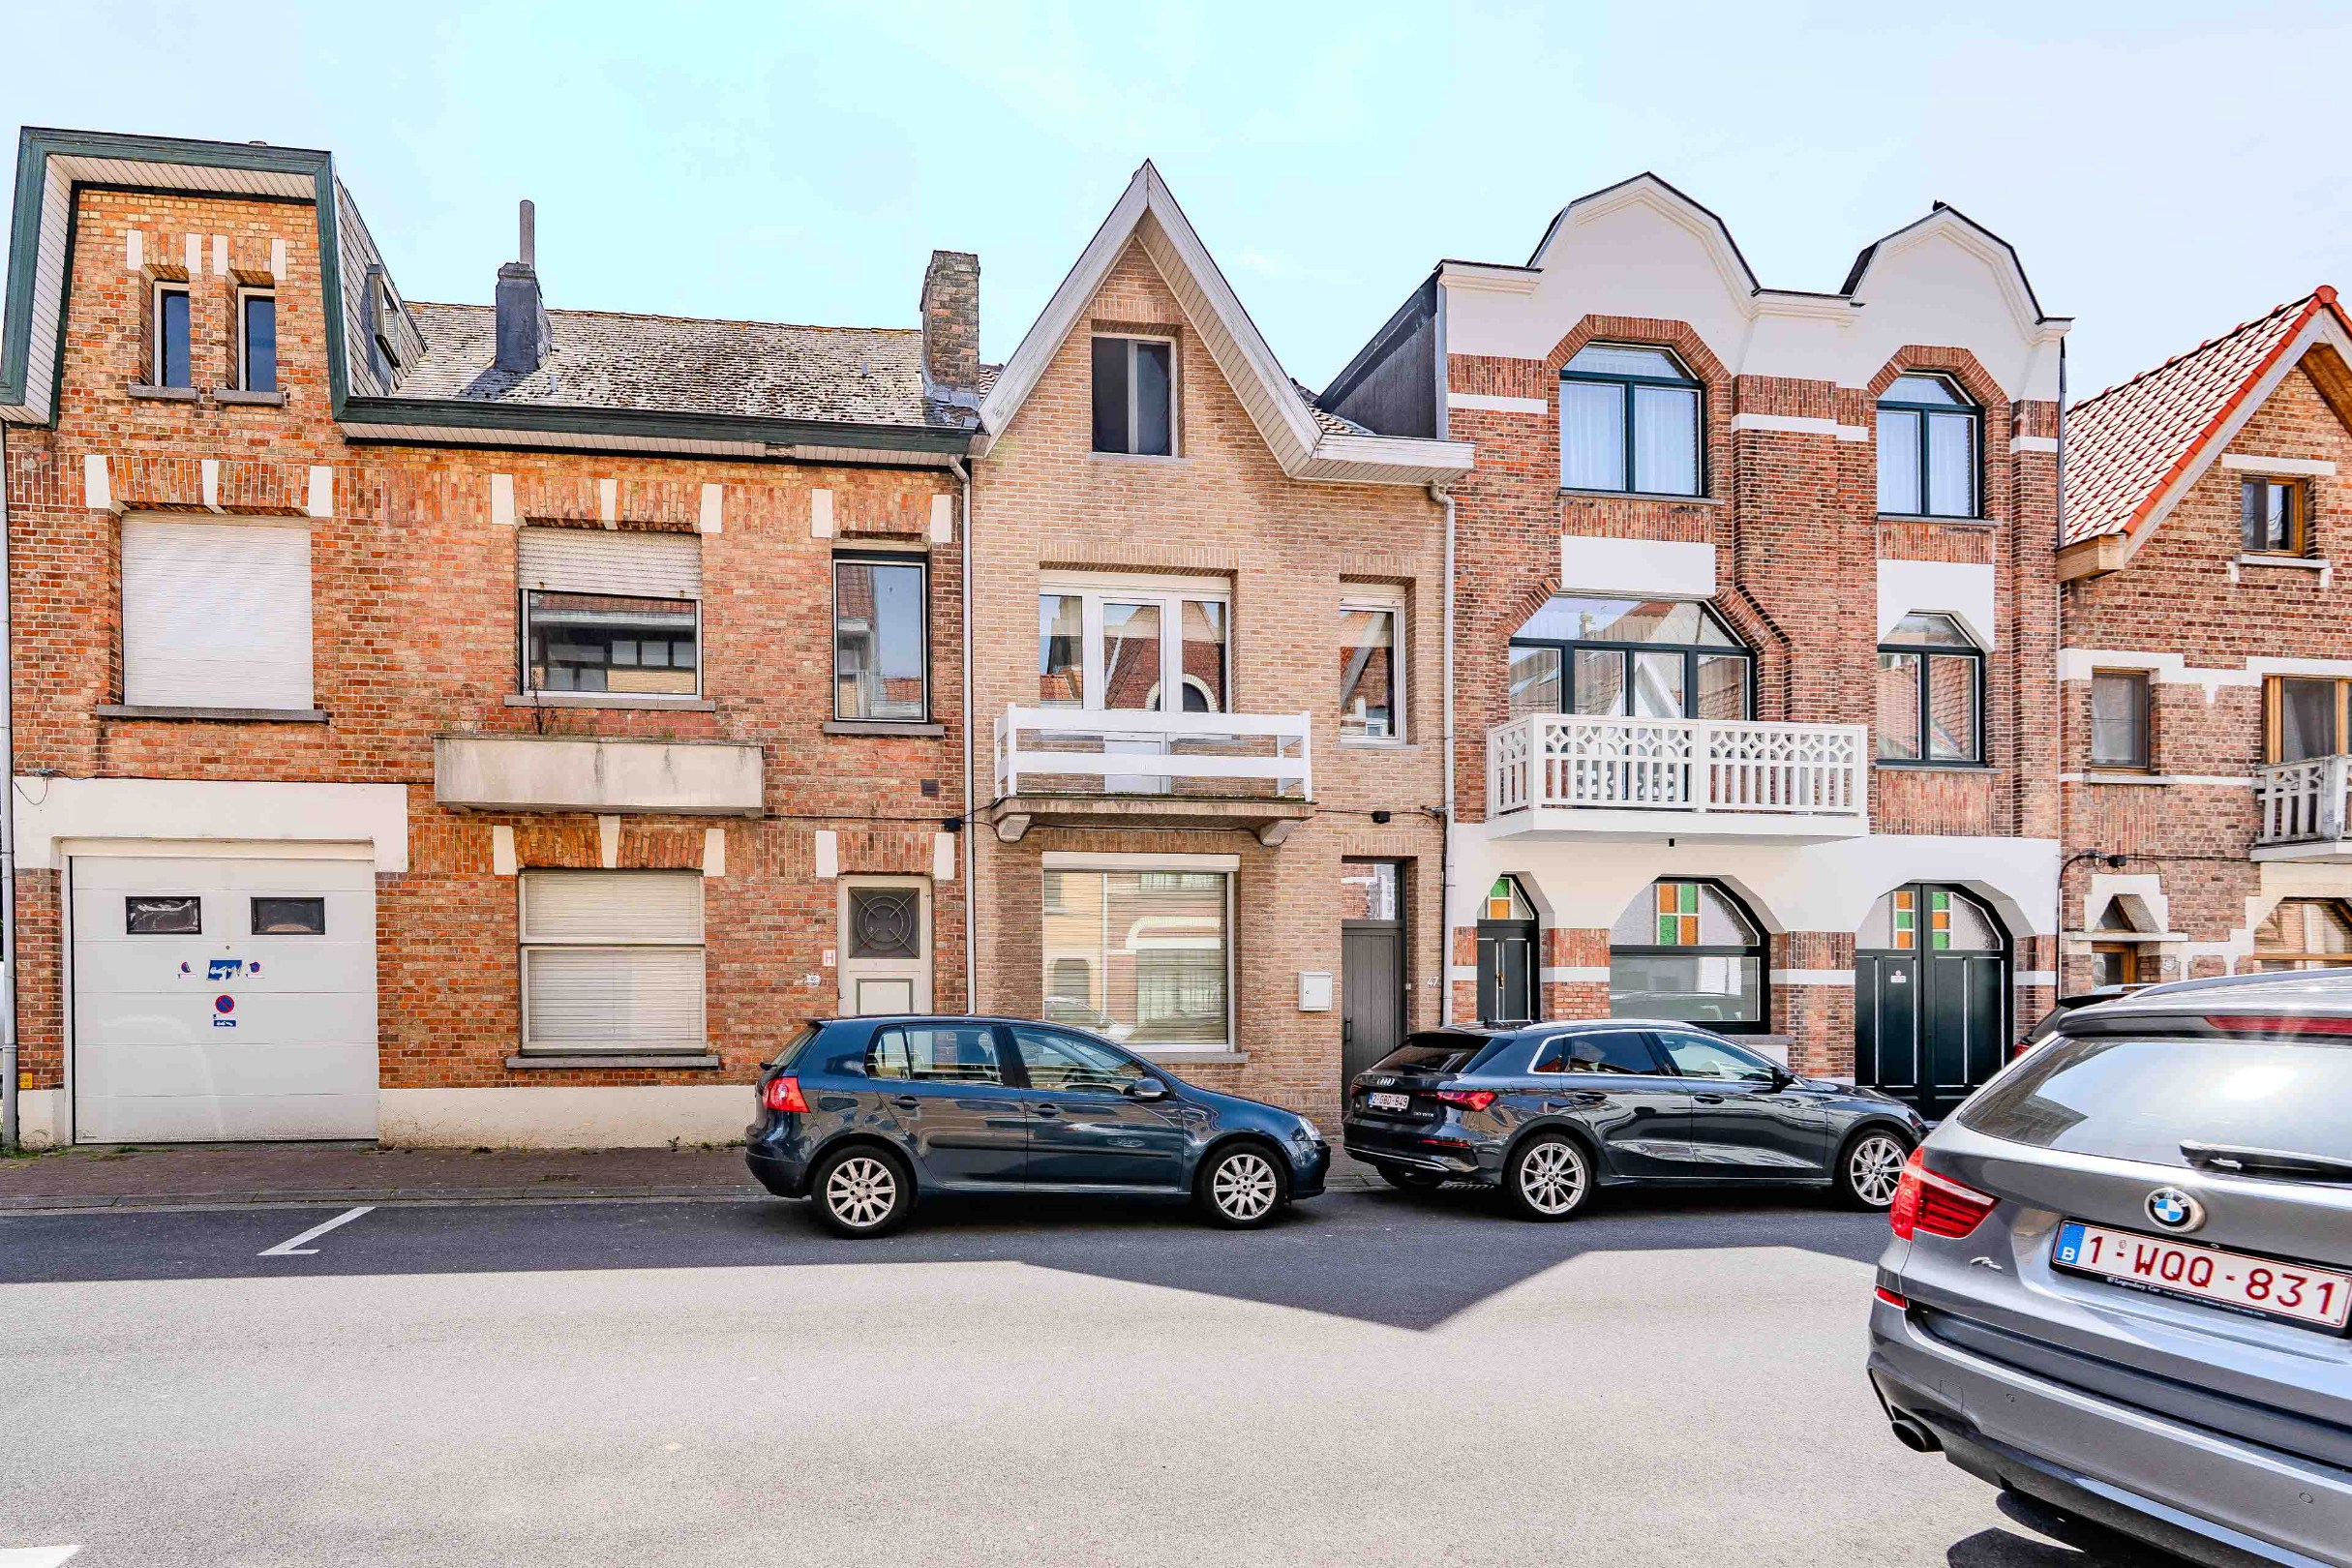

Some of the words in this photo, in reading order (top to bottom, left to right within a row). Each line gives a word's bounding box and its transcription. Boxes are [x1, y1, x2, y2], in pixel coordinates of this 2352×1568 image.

[1427, 976, 1439, 987] 47
[2061, 1246, 2076, 1262] B
[2089, 1235, 2336, 1315] 1-WQQ-831
[2114, 1278, 2146, 1290] Legendary
